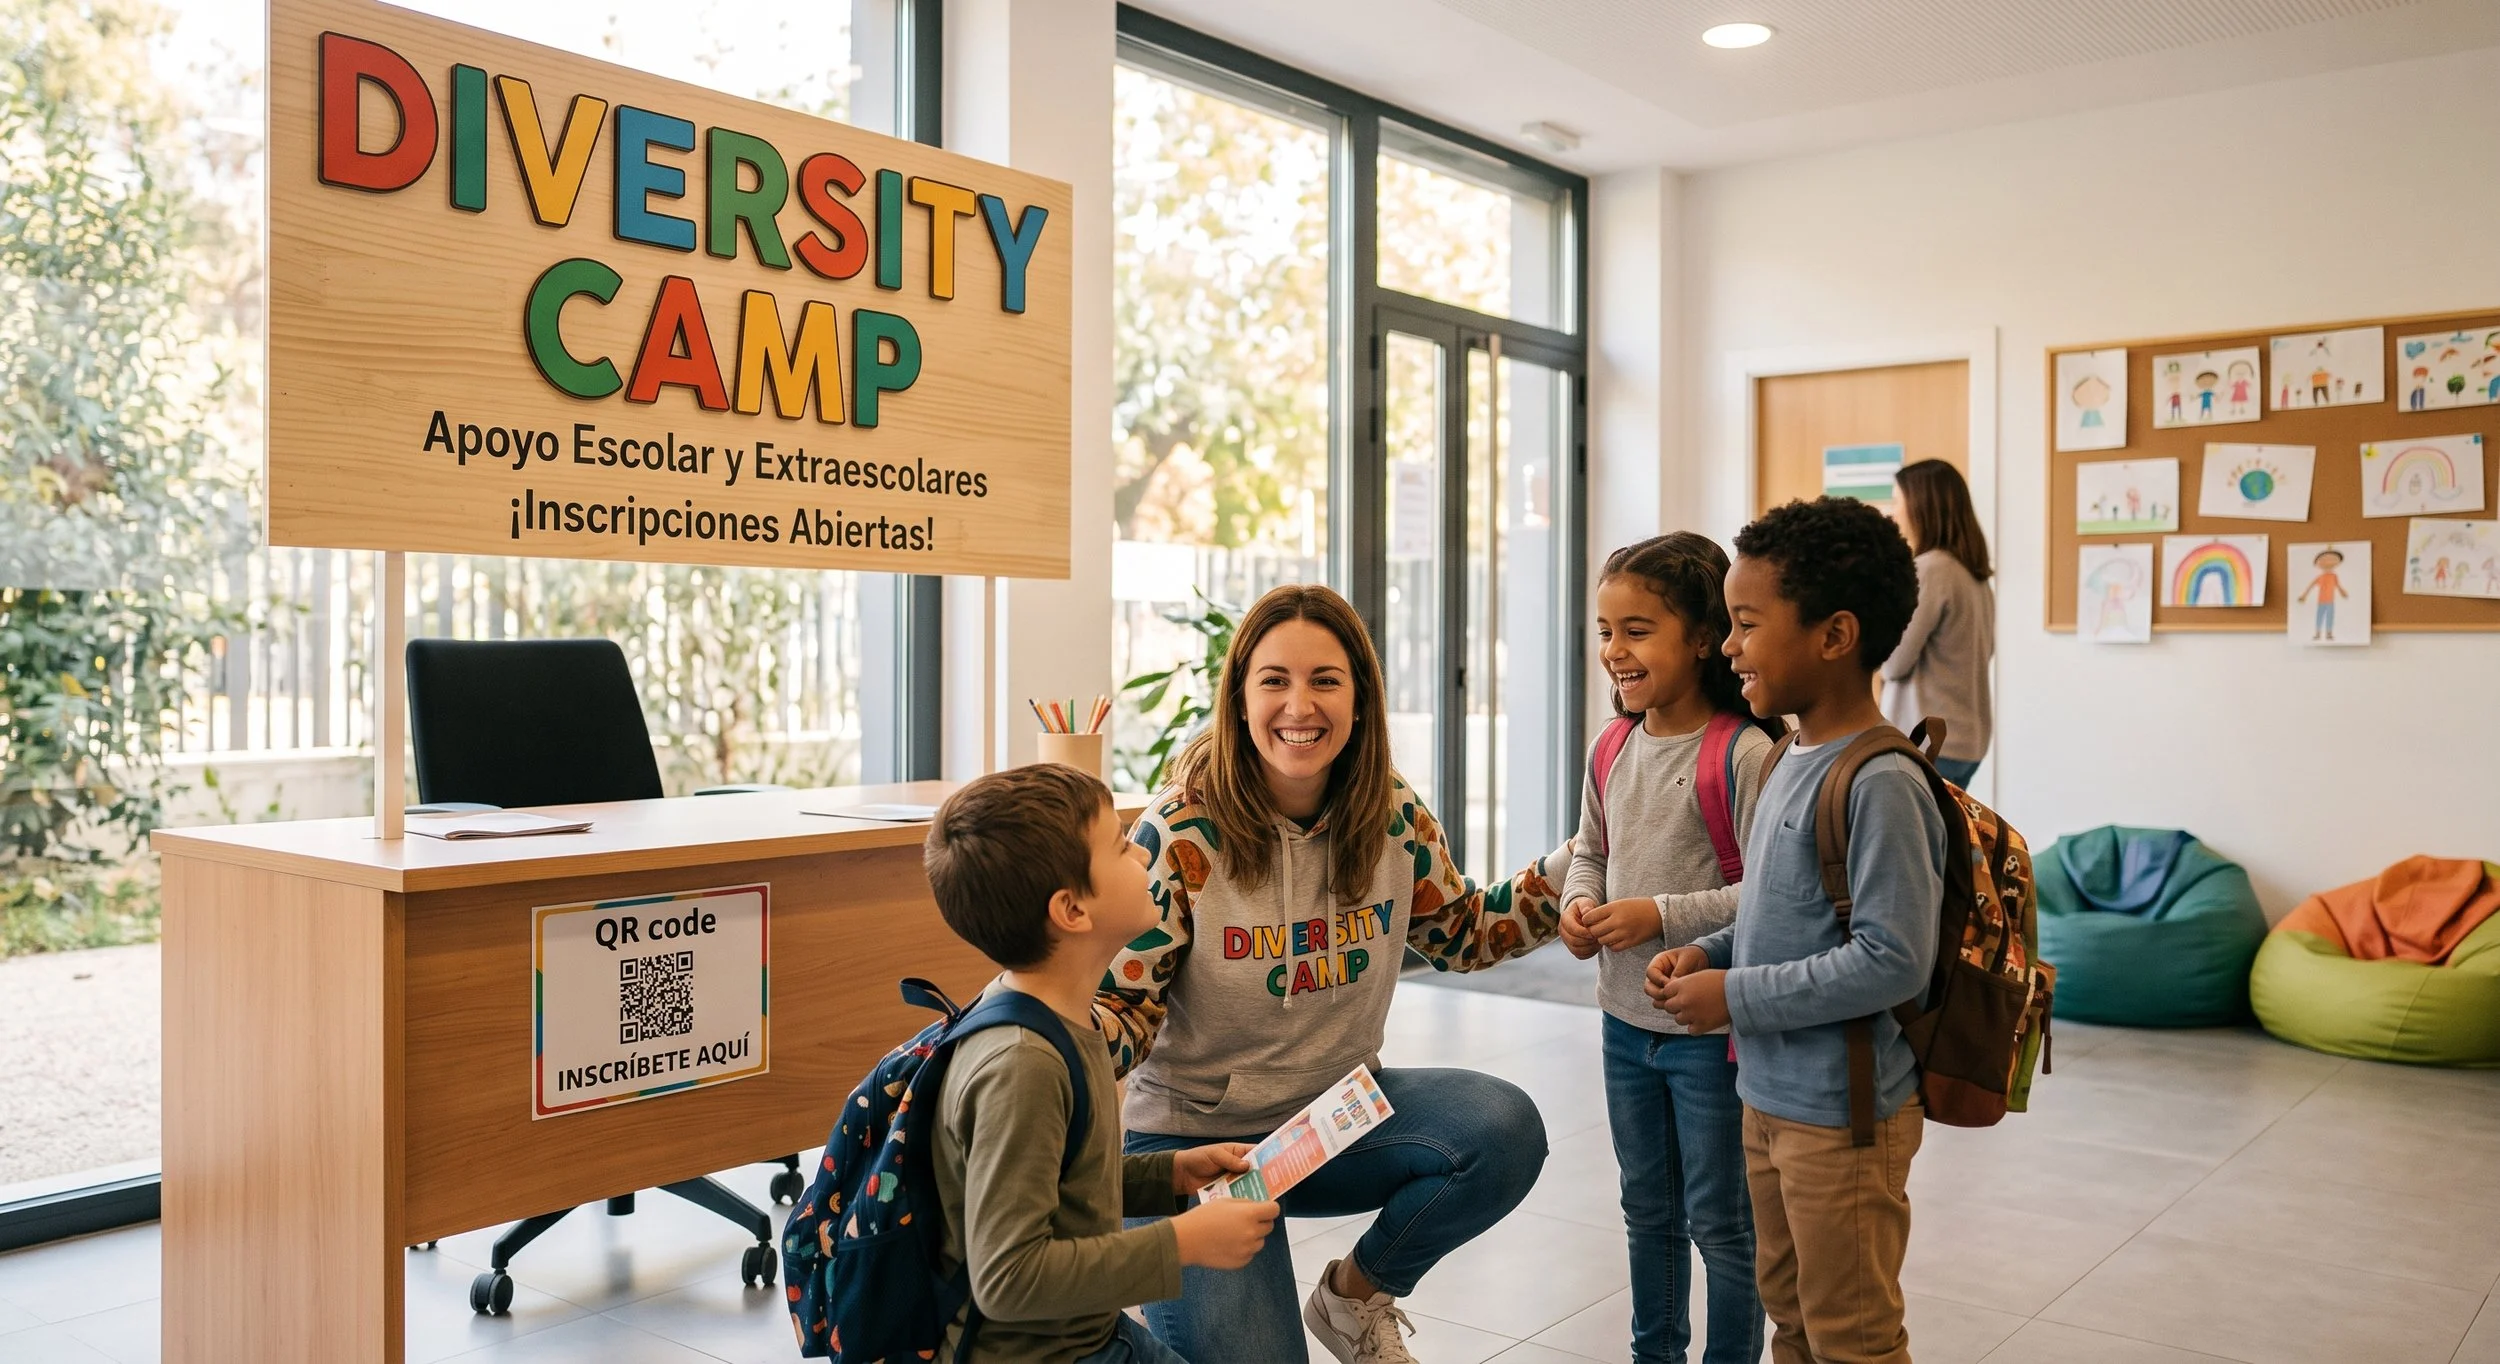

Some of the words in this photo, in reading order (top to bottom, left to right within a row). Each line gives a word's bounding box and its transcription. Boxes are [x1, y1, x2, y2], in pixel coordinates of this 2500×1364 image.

[318, 30, 1049, 314] DIVERSITY
[524, 257, 923, 429] CAMP
[422, 410, 560, 471] Apoyo
[572, 424, 715, 474] Escolar
[723, 447, 743, 488] y
[755, 442, 989, 499] Extraescolares
[510, 488, 781, 545] ¡Inscripciones
[789, 507, 935, 552] Abiertas!
[596, 916, 639, 950] QR
[648, 907, 716, 940] code
[1224, 899, 1394, 959] DIVERSITY
[1266, 948, 1369, 997] CAMP
[558, 1049, 690, 1091] INSCRÍBETE
[696, 1031, 751, 1065] AQUÍ
